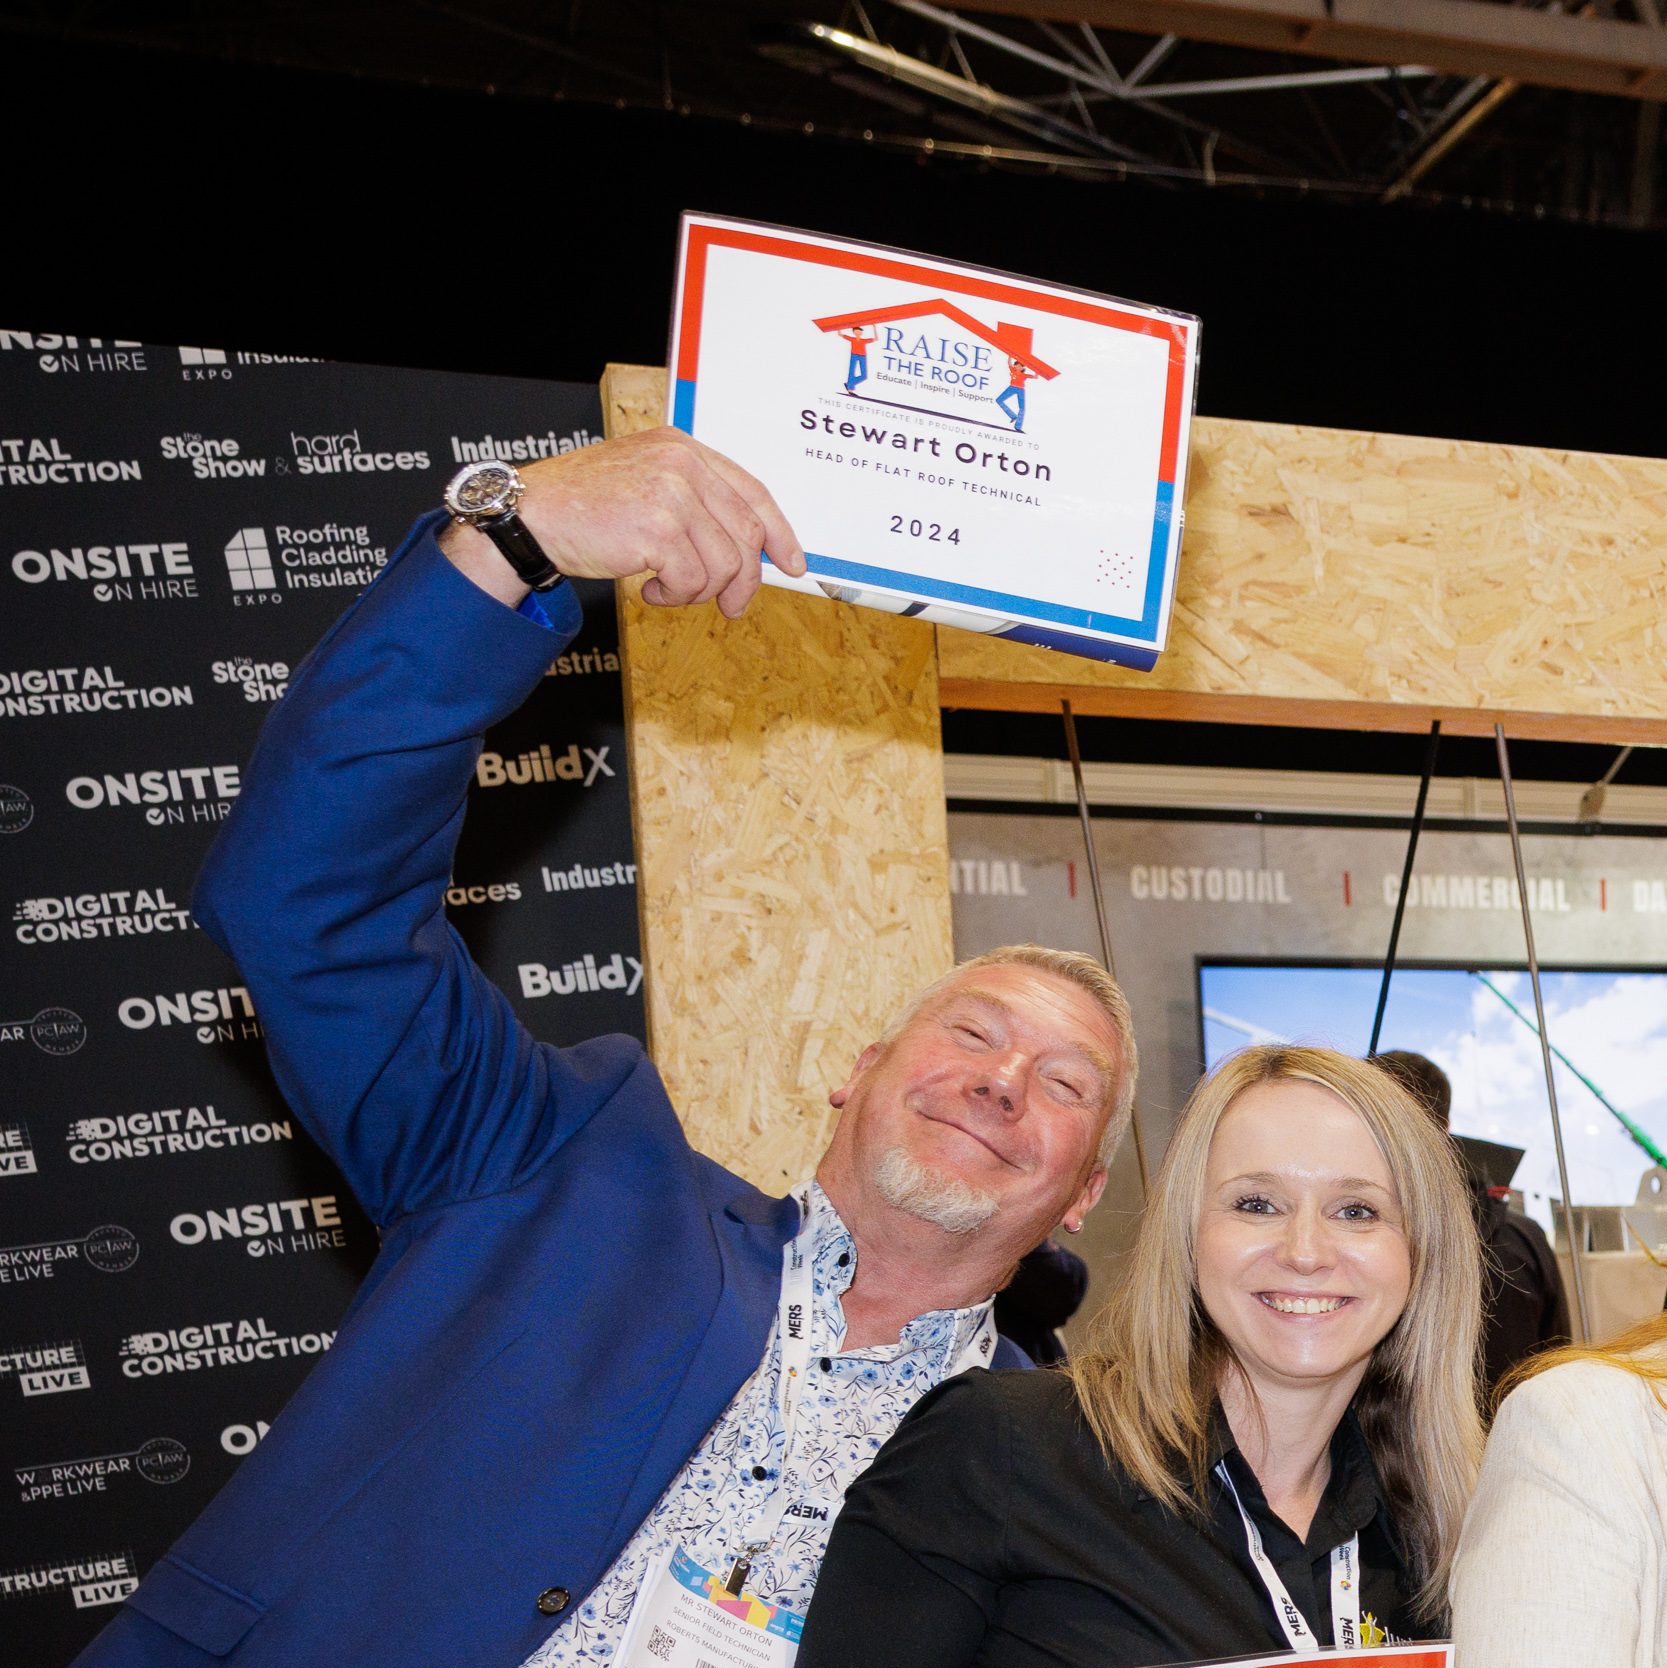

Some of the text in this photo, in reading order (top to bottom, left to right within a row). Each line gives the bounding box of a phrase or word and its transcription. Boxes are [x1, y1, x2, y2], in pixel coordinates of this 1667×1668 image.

[87, 352, 148, 372] HIRE
[882, 326, 993, 372] RAISE
[182, 369, 233, 381] EXPO
[876, 371, 994, 405] Educate Inspire Support
[884, 355, 990, 391] THE ROOF
[160, 436, 240, 459] Stone
[290, 429, 361, 456] hard
[800, 409, 1052, 482] Stewart Orton
[192, 456, 266, 479] Show
[296, 448, 431, 475] surfaces
[805, 447, 1041, 507] HEAD OF FLAT ROOF TECHNICAL
[275, 523, 370, 545] Roofing
[890, 515, 961, 546] 2024
[12, 543, 193, 583] ONSITE
[281, 545, 388, 567] Cladding
[140, 579, 199, 600] HIRE
[233, 593, 282, 606] EXPO
[212, 661, 289, 684] Stone
[66, 765, 241, 809] ONSITE
[191, 801, 237, 824] HIR
[1129, 864, 1292, 904] CUSTODIAL
[40, 888, 176, 921] DIGITAL
[16, 910, 199, 944] CONSTRUCT
[118, 987, 255, 1030] ONSIT
[95, 1105, 227, 1141] DIGITAL
[69, 1120, 293, 1164] CONSTRUCTION
[170, 1196, 341, 1245] ONSITE
[292, 1229, 347, 1253] HIRE
[15, 1264, 55, 1283] LIVE
[147, 1318, 276, 1355] DIGITAL
[789, 1303, 803, 1340] MERS
[27, 1371, 83, 1392] LIVE
[68, 1477, 107, 1496] LIVE
[80, 1582, 133, 1603] LIVE
[666, 1620, 700, 1644] ROBERTS
[673, 1606, 771, 1662] SENIOR FIELD TECHNICIAN
[680, 1593, 695, 1608] MR
[696, 1602, 737, 1631] STEWART
[739, 1625, 773, 1647] ORTON
